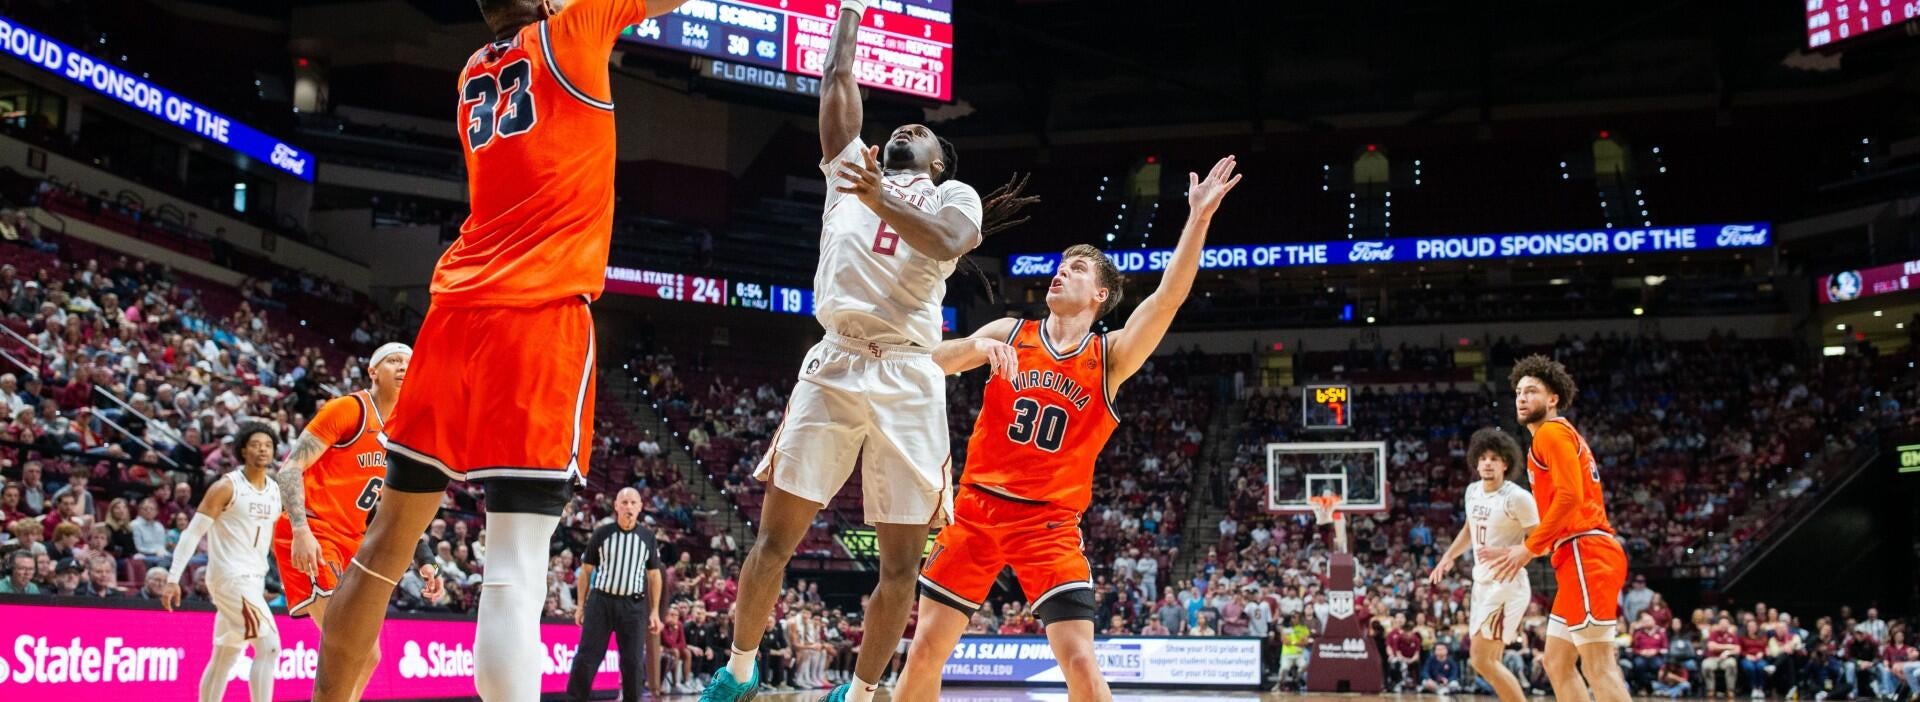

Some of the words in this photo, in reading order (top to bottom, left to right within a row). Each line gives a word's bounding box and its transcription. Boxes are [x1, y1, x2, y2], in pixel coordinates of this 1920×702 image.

[673, 0, 718, 20] OWN
[727, 33, 749, 57] 30
[711, 61, 788, 89] FLORIDA
[0, 19, 63, 70] ROUD
[65, 51, 163, 115] SPONSOR
[165, 96, 193, 126] OF
[194, 106, 231, 144] THE
[270, 142, 306, 176] Ford
[462, 57, 538, 154] 33
[871, 219, 900, 256] 6
[1011, 255, 1055, 276] Ford
[1251, 246, 1282, 266] OF
[1284, 244, 1328, 264] THE
[1348, 240, 1395, 262] Ford
[1416, 237, 1496, 259] PROUD
[1500, 232, 1609, 256] SPONSOR
[1613, 230, 1646, 251] OF
[1648, 228, 1697, 249] THE
[1715, 225, 1768, 247] Ford
[606, 266, 642, 283] LORIDA
[642, 270, 674, 287] STATE
[691, 276, 720, 305] 24
[780, 287, 802, 313] 19
[1010, 368, 1092, 412] VIRGINIA
[1315, 386, 1347, 404] 6:54
[1006, 396, 1070, 453] 30
[1327, 402, 1345, 426] 7
[355, 475, 385, 511] 6
[248, 501, 272, 516] FSU
[252, 524, 262, 549] 1
[1475, 524, 1487, 546] 10
[964, 642, 978, 660] A
[977, 642, 1020, 660] SLAM
[1187, 646, 1203, 654] your
[1219, 644, 1239, 654] pride
[1241, 645, 1255, 653] and
[1107, 654, 1140, 669] NOLES
[1149, 657, 1179, 667] support
[1180, 656, 1208, 665] student
[1170, 669, 1185, 678] Get
[1185, 670, 1202, 679] your
[1218, 669, 1231, 680] tag
